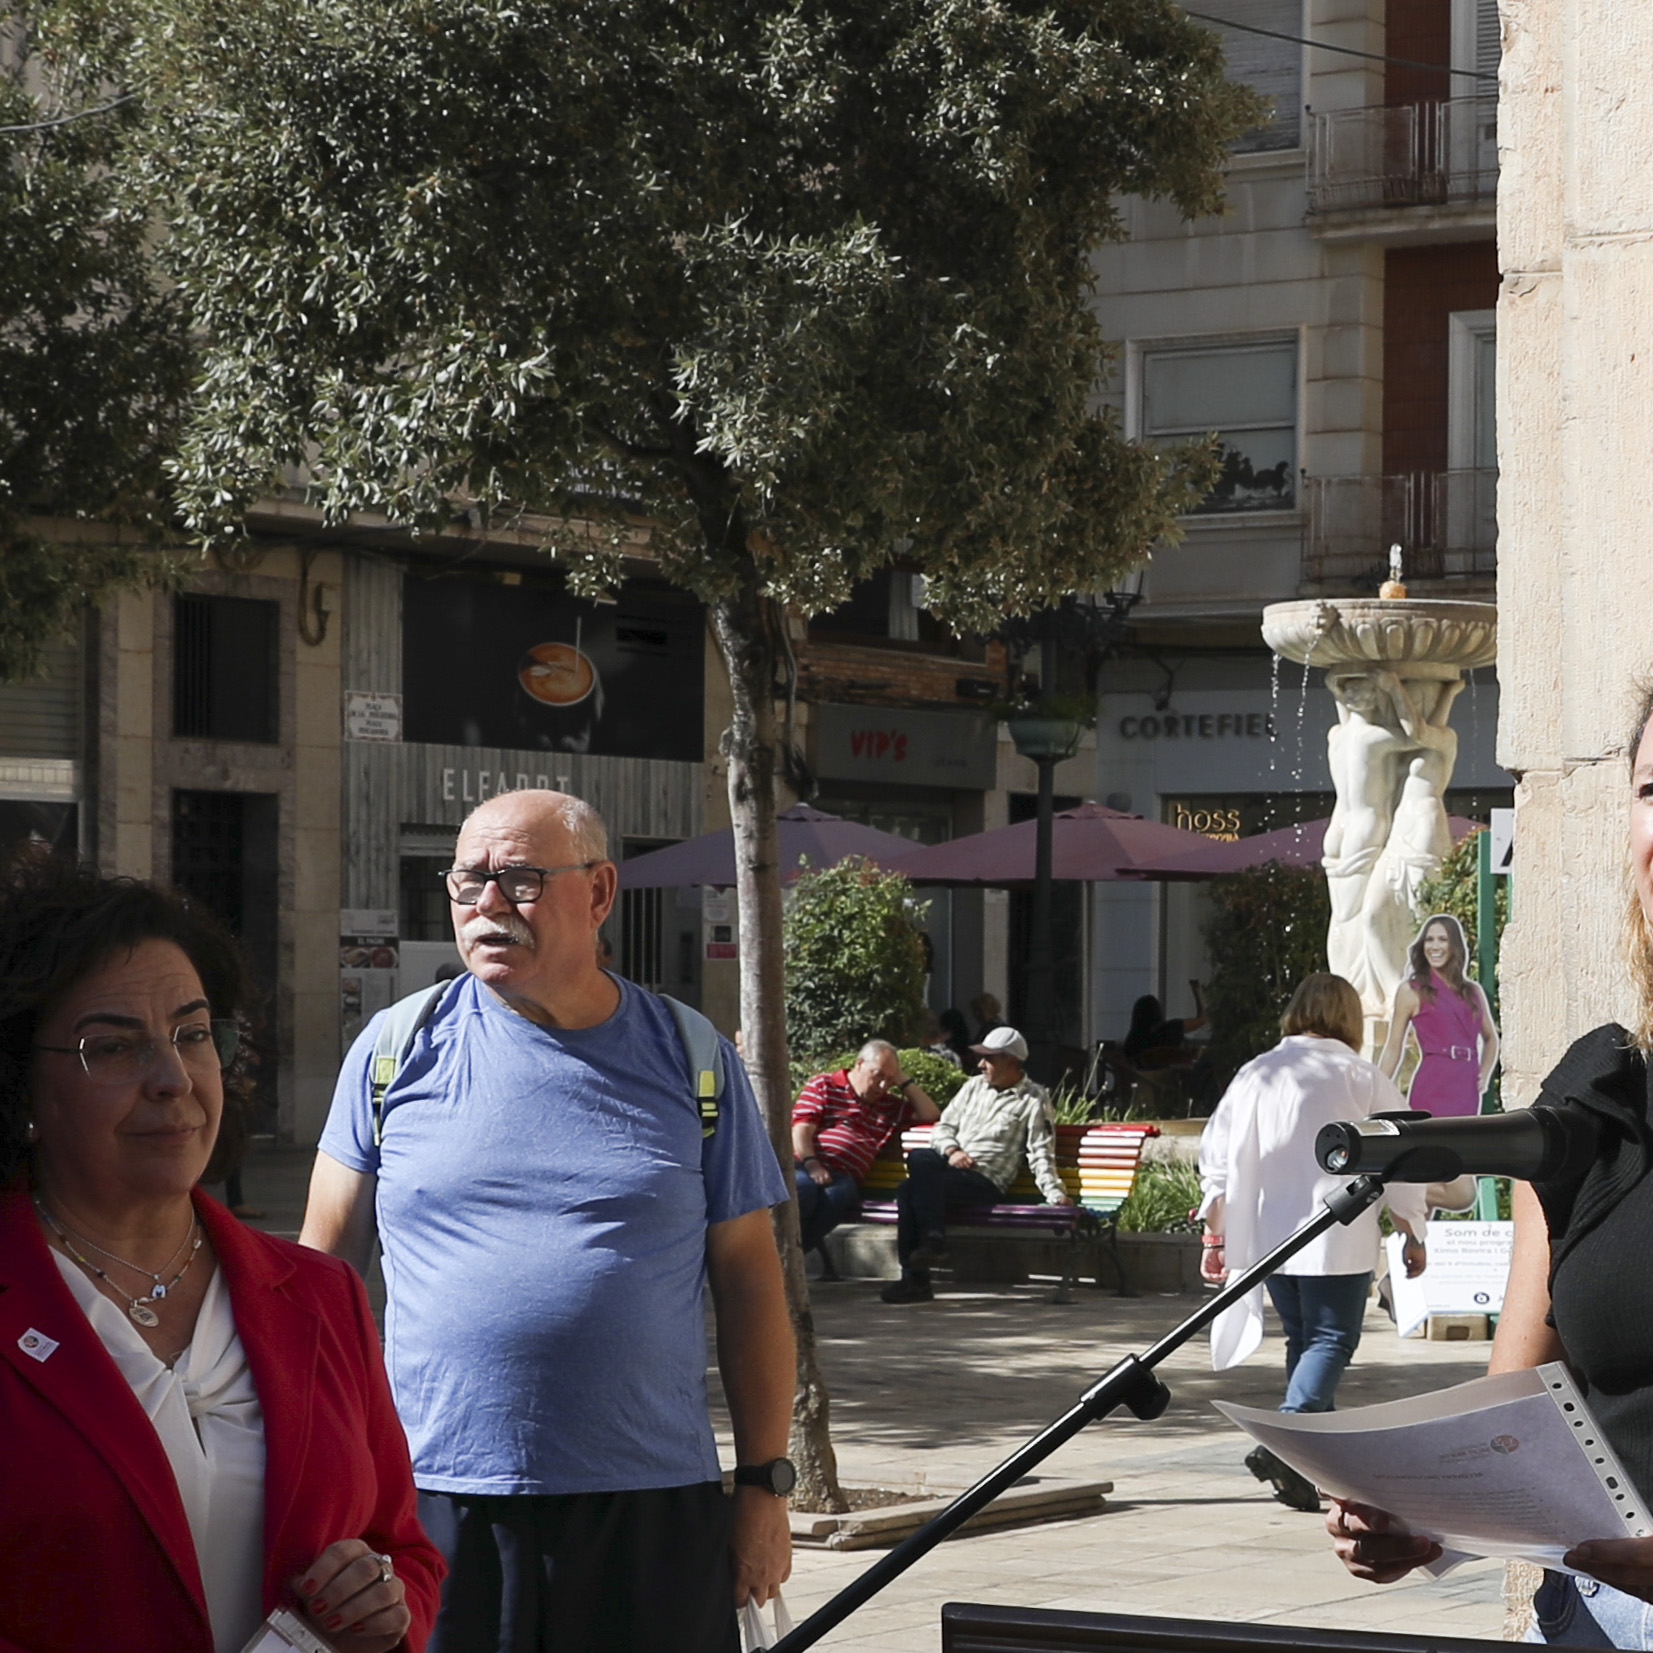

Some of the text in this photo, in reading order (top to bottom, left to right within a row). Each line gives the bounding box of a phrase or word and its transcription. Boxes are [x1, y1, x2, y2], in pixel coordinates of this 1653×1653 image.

[1119, 712, 1279, 740] CORTEFIEL
[1176, 803, 1241, 832] hoss
[1444, 1227, 1513, 1238] Som de c
